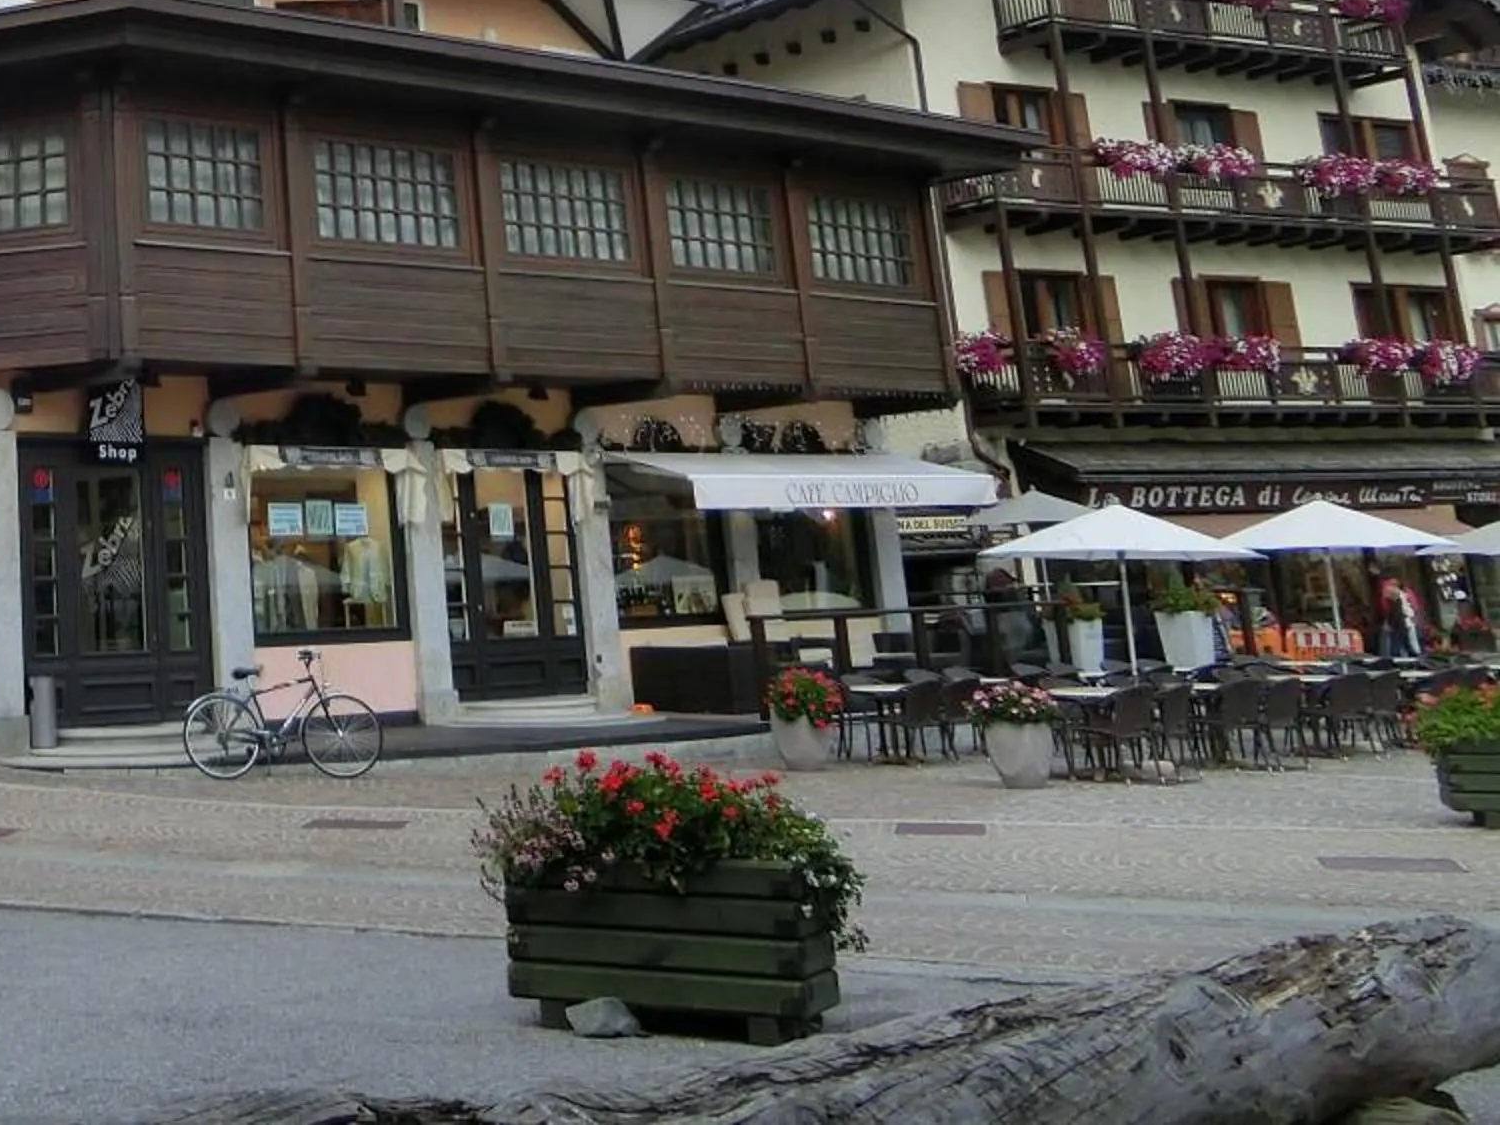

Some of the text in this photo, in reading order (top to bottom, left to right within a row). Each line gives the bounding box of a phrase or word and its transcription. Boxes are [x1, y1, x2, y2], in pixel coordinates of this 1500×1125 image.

[99, 444, 137, 463] Shop
[832, 481, 919, 503] CAMPIGLIO
[1130, 486, 1246, 508] BOTTEGA
[1257, 484, 1281, 506] di
